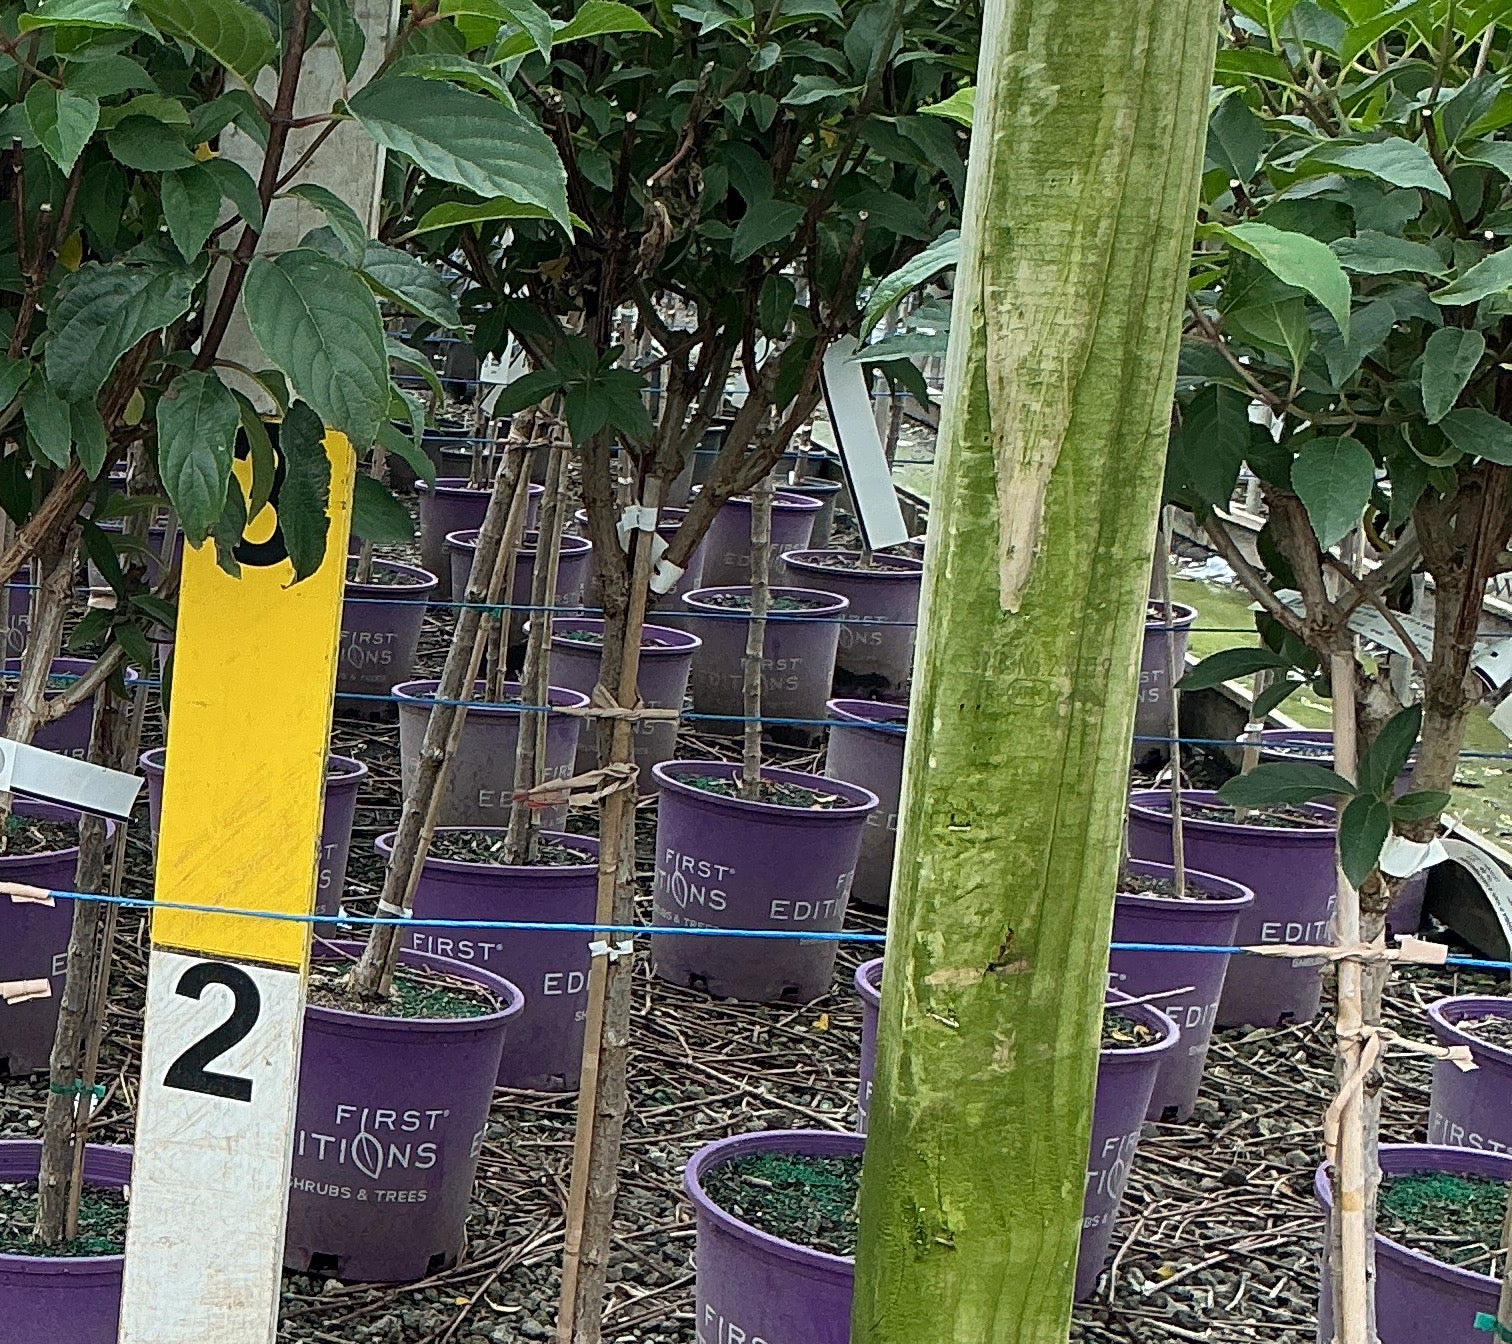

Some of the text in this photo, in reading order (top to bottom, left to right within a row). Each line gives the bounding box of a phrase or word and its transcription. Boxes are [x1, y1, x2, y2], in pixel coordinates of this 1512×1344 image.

[162, 962, 261, 1102] 2
[299, 1130, 437, 1180] ITIONS
[357, 1187, 368, 1202] &
[375, 1188, 428, 1203] TREES
